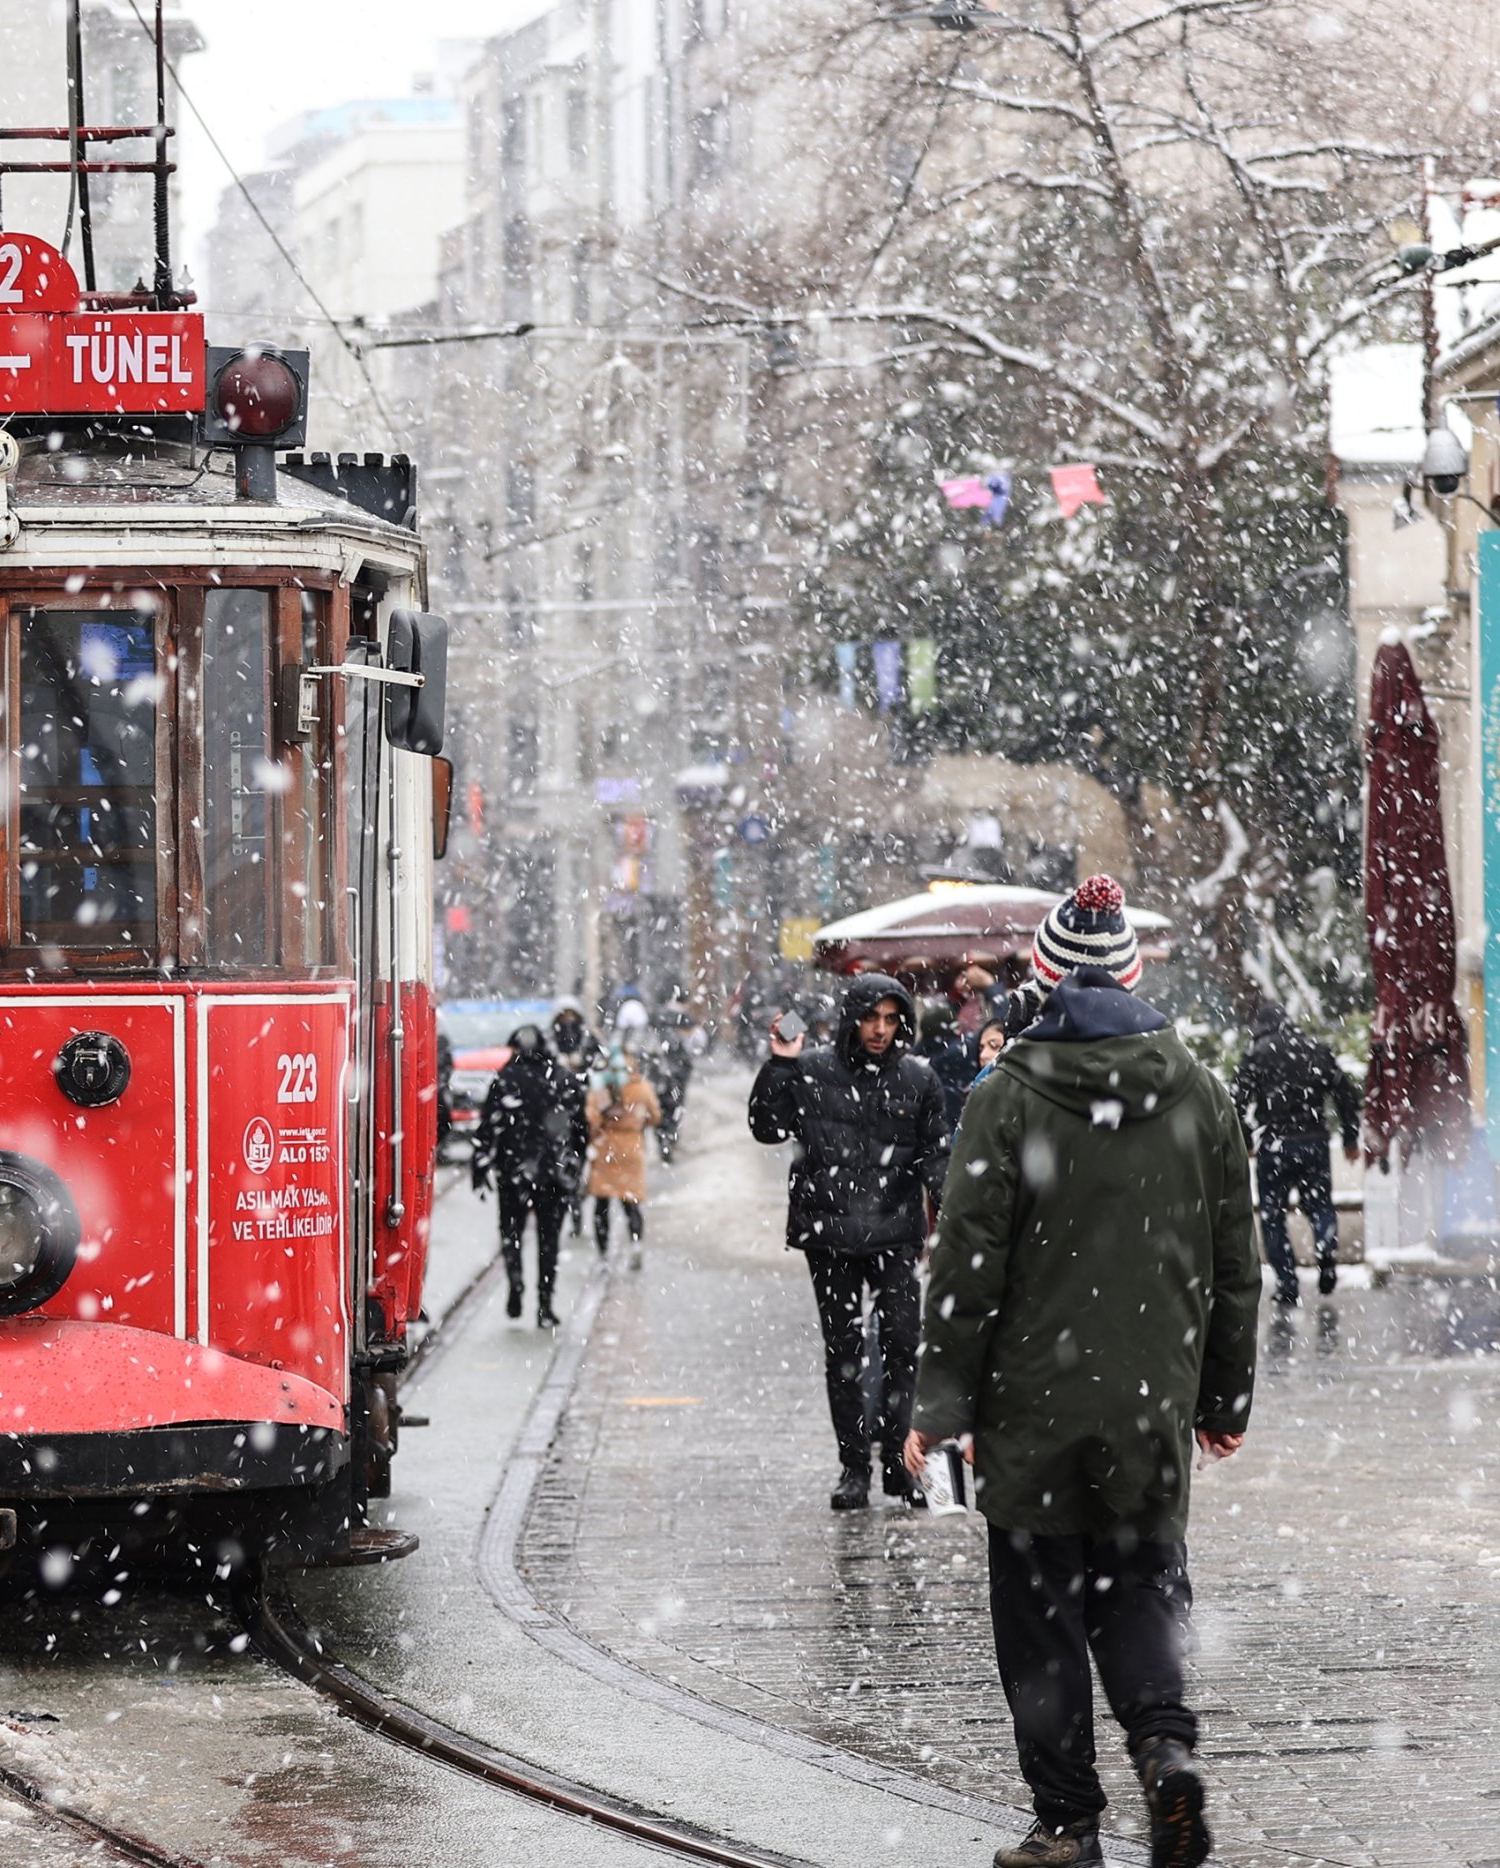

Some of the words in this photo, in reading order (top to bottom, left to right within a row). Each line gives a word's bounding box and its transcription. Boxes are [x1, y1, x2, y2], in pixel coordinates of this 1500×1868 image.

[66, 322, 192, 383] TÜNEL
[277, 1053, 317, 1104] 223
[279, 1147, 307, 1163] ALO
[310, 1146, 328, 1162] 153
[236, 1188, 300, 1211] ASILMAK
[232, 1221, 253, 1241] VE
[256, 1211, 333, 1240] TEHLİKELİDİR
